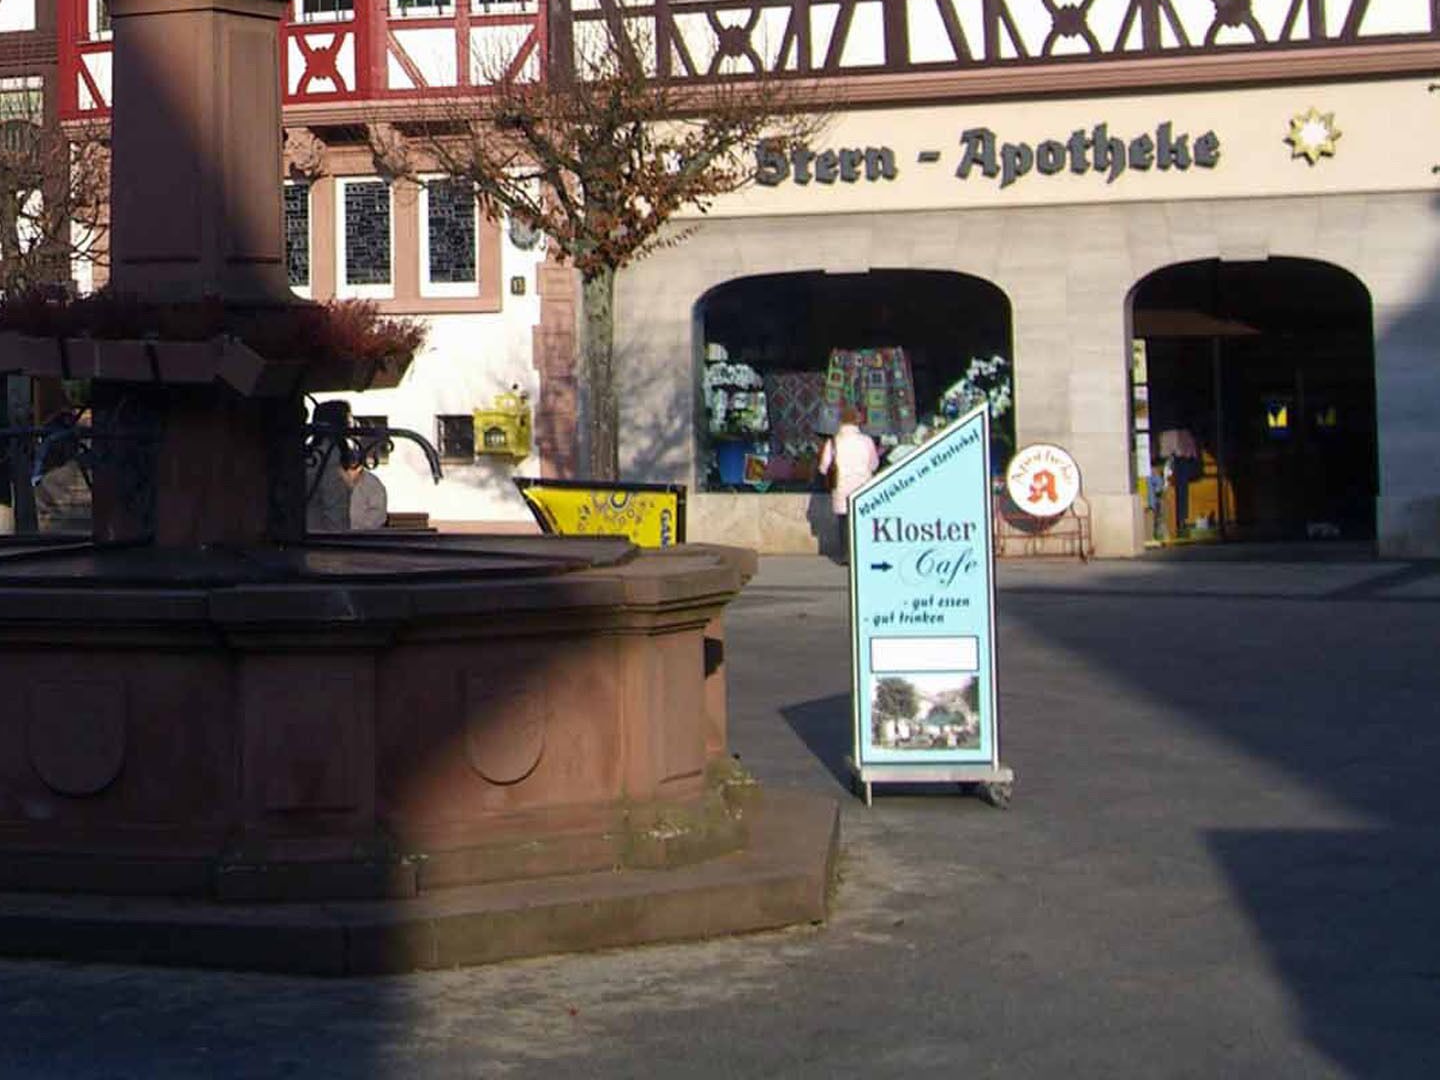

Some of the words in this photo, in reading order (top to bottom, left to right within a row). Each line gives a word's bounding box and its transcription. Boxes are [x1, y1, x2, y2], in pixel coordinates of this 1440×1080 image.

[755, 137, 898, 187] Stern
[954, 120, 1221, 189] Apotheke
[917, 465, 931, 480] im
[871, 517, 977, 543] Kloster
[912, 593, 935, 610] gut
[937, 597, 971, 608] essen
[873, 610, 895, 627] gut
[898, 610, 945, 624] trinken
